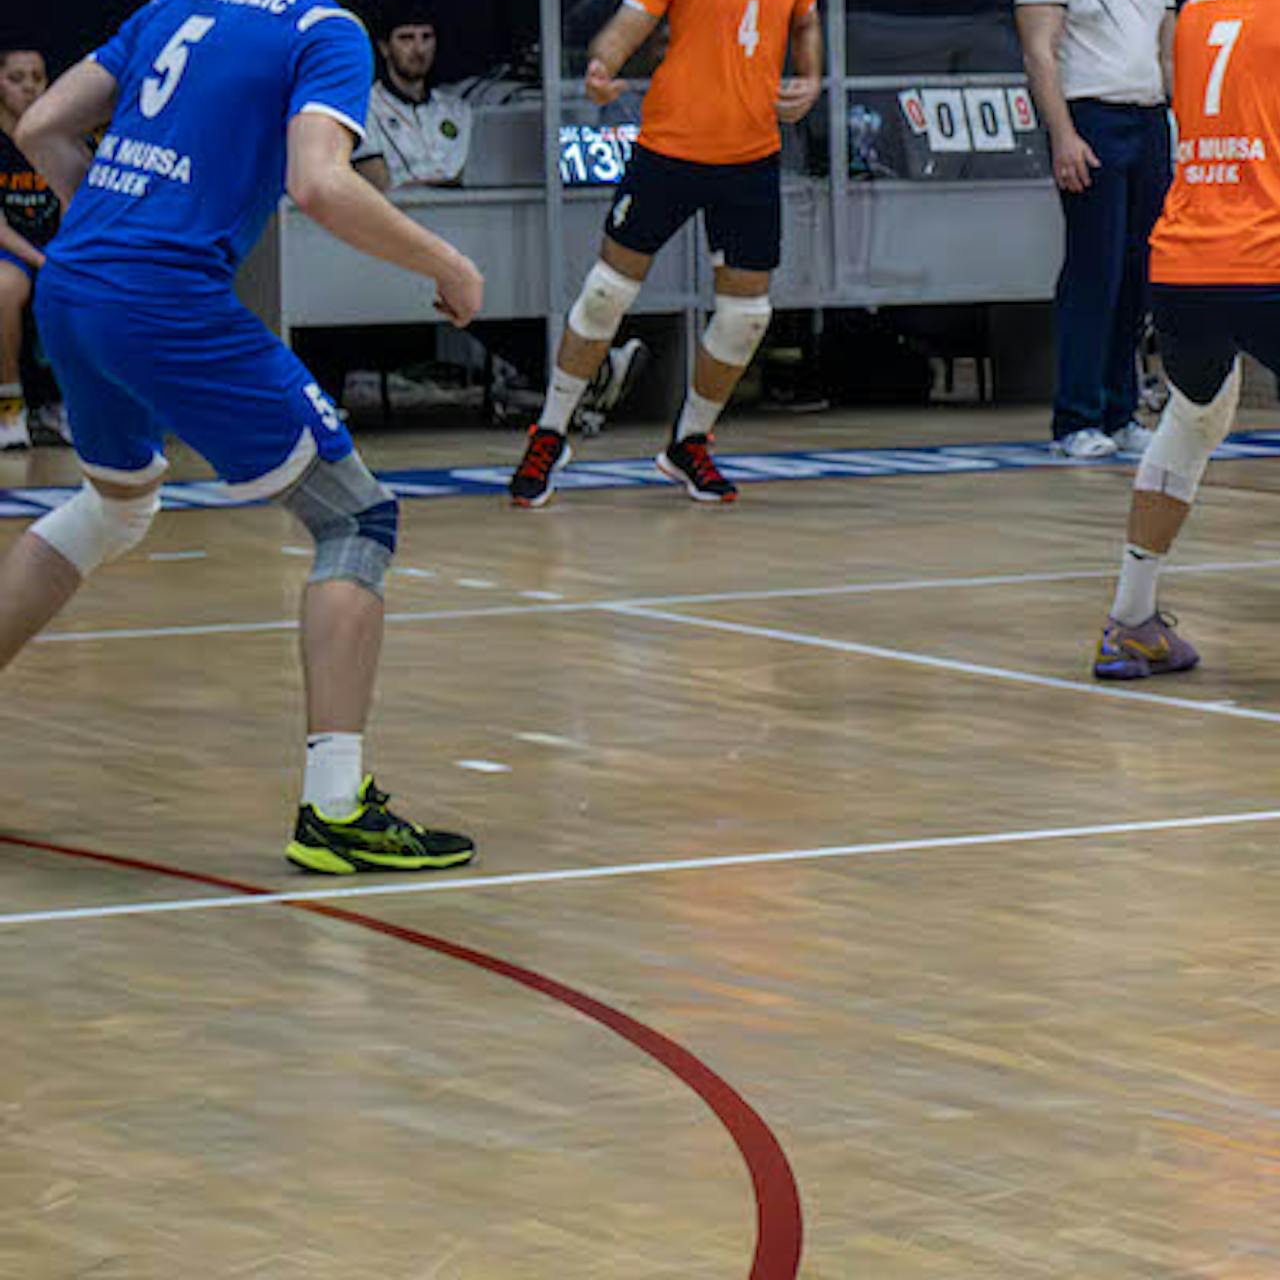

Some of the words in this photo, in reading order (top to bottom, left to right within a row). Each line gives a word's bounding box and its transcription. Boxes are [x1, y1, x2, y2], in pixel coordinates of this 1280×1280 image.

[139, 14, 216, 119] 5
[1203, 19, 1243, 117] 7
[936, 102, 955, 139] 0
[979, 101, 999, 137] 0
[115, 138, 192, 184] MURSA
[1198, 136, 1266, 161] MURSA
